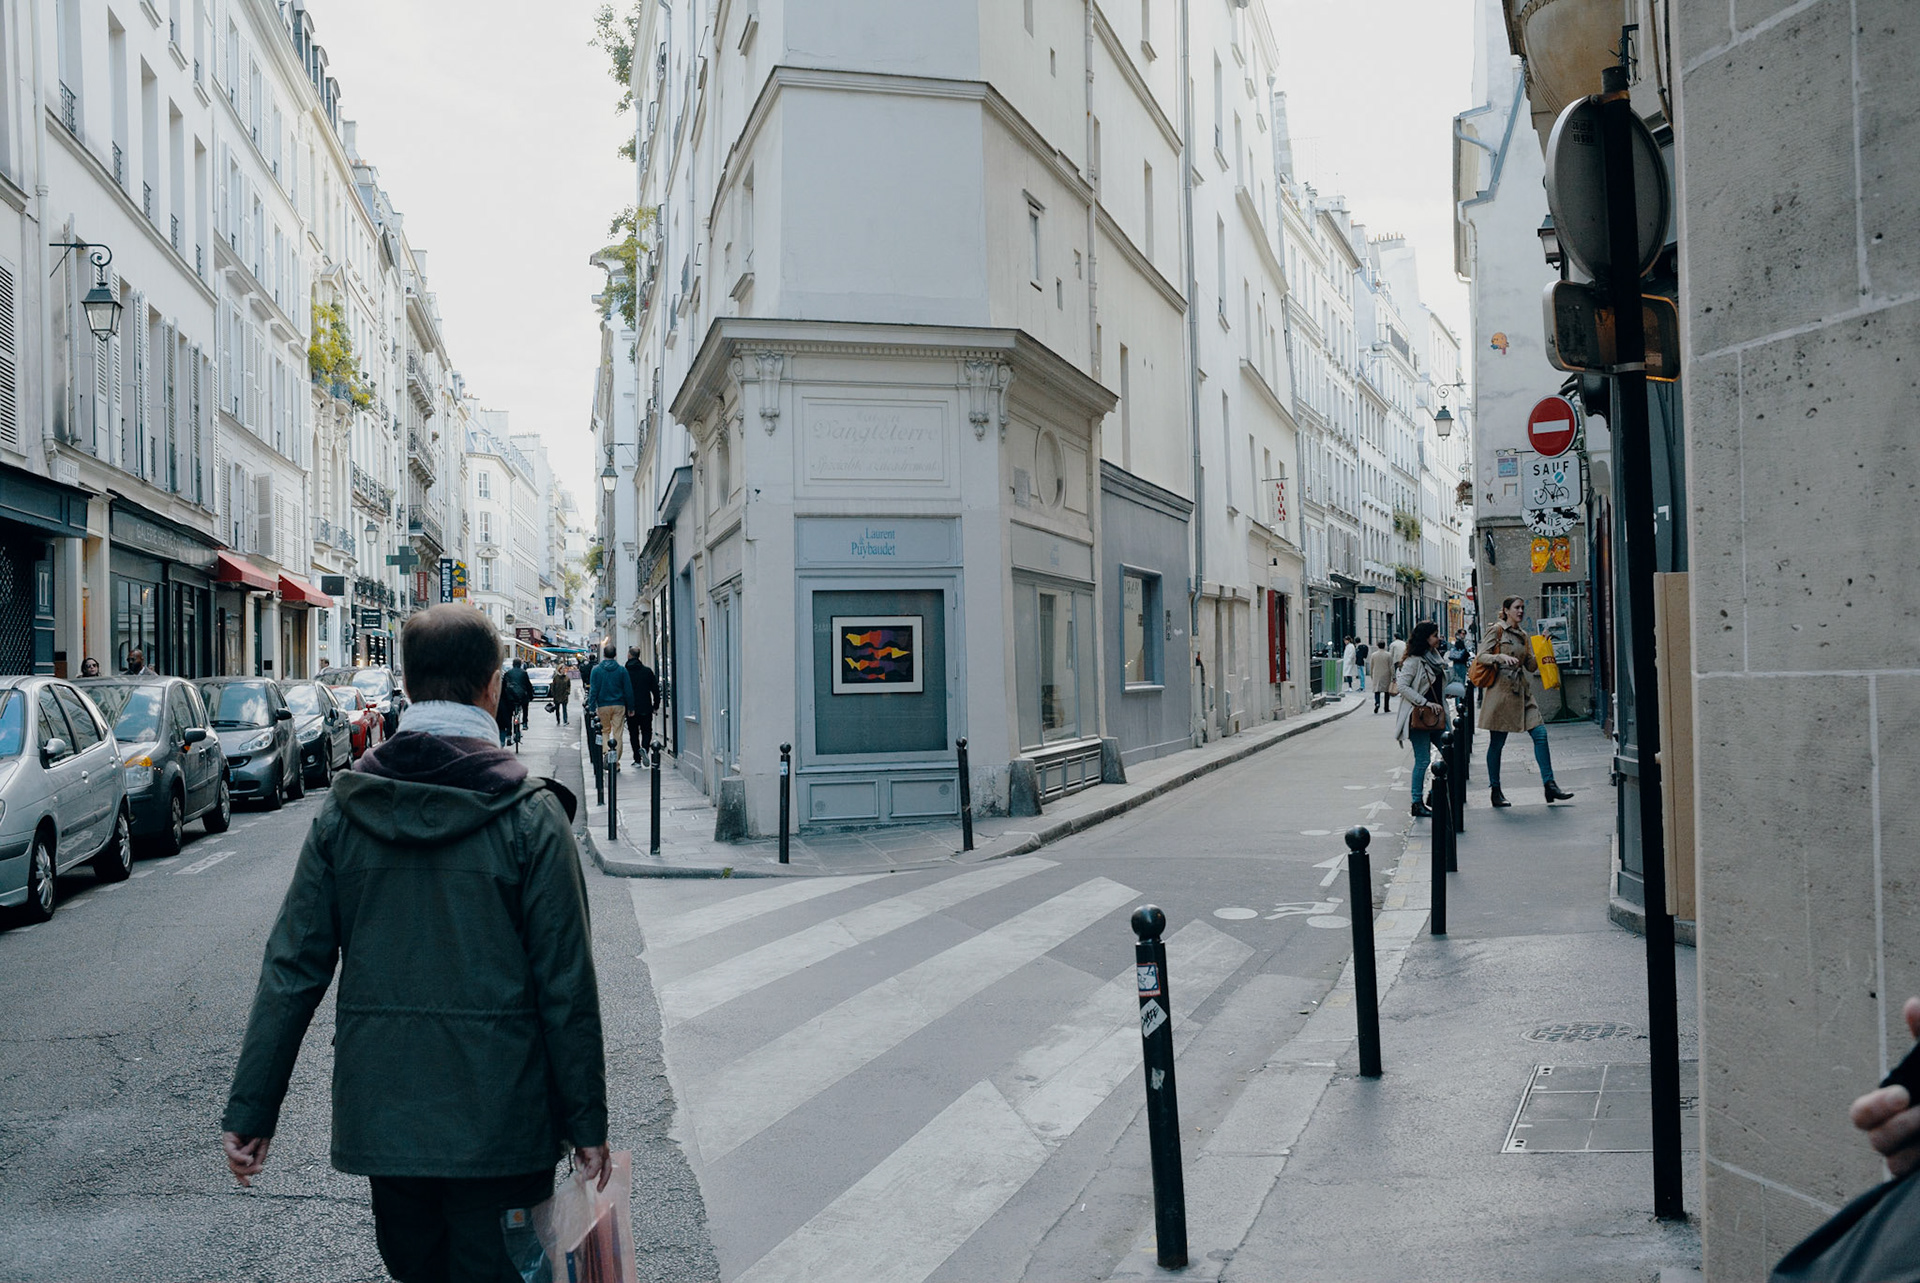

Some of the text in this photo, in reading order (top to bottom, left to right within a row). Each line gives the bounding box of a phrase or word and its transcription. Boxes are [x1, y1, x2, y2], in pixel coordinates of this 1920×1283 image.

[1533, 460, 1570, 476] SAUF
[865, 527, 896, 540] Laurent
[1526, 518, 1575, 536] JOUETS
[851, 541, 896, 559] Puybaudet
